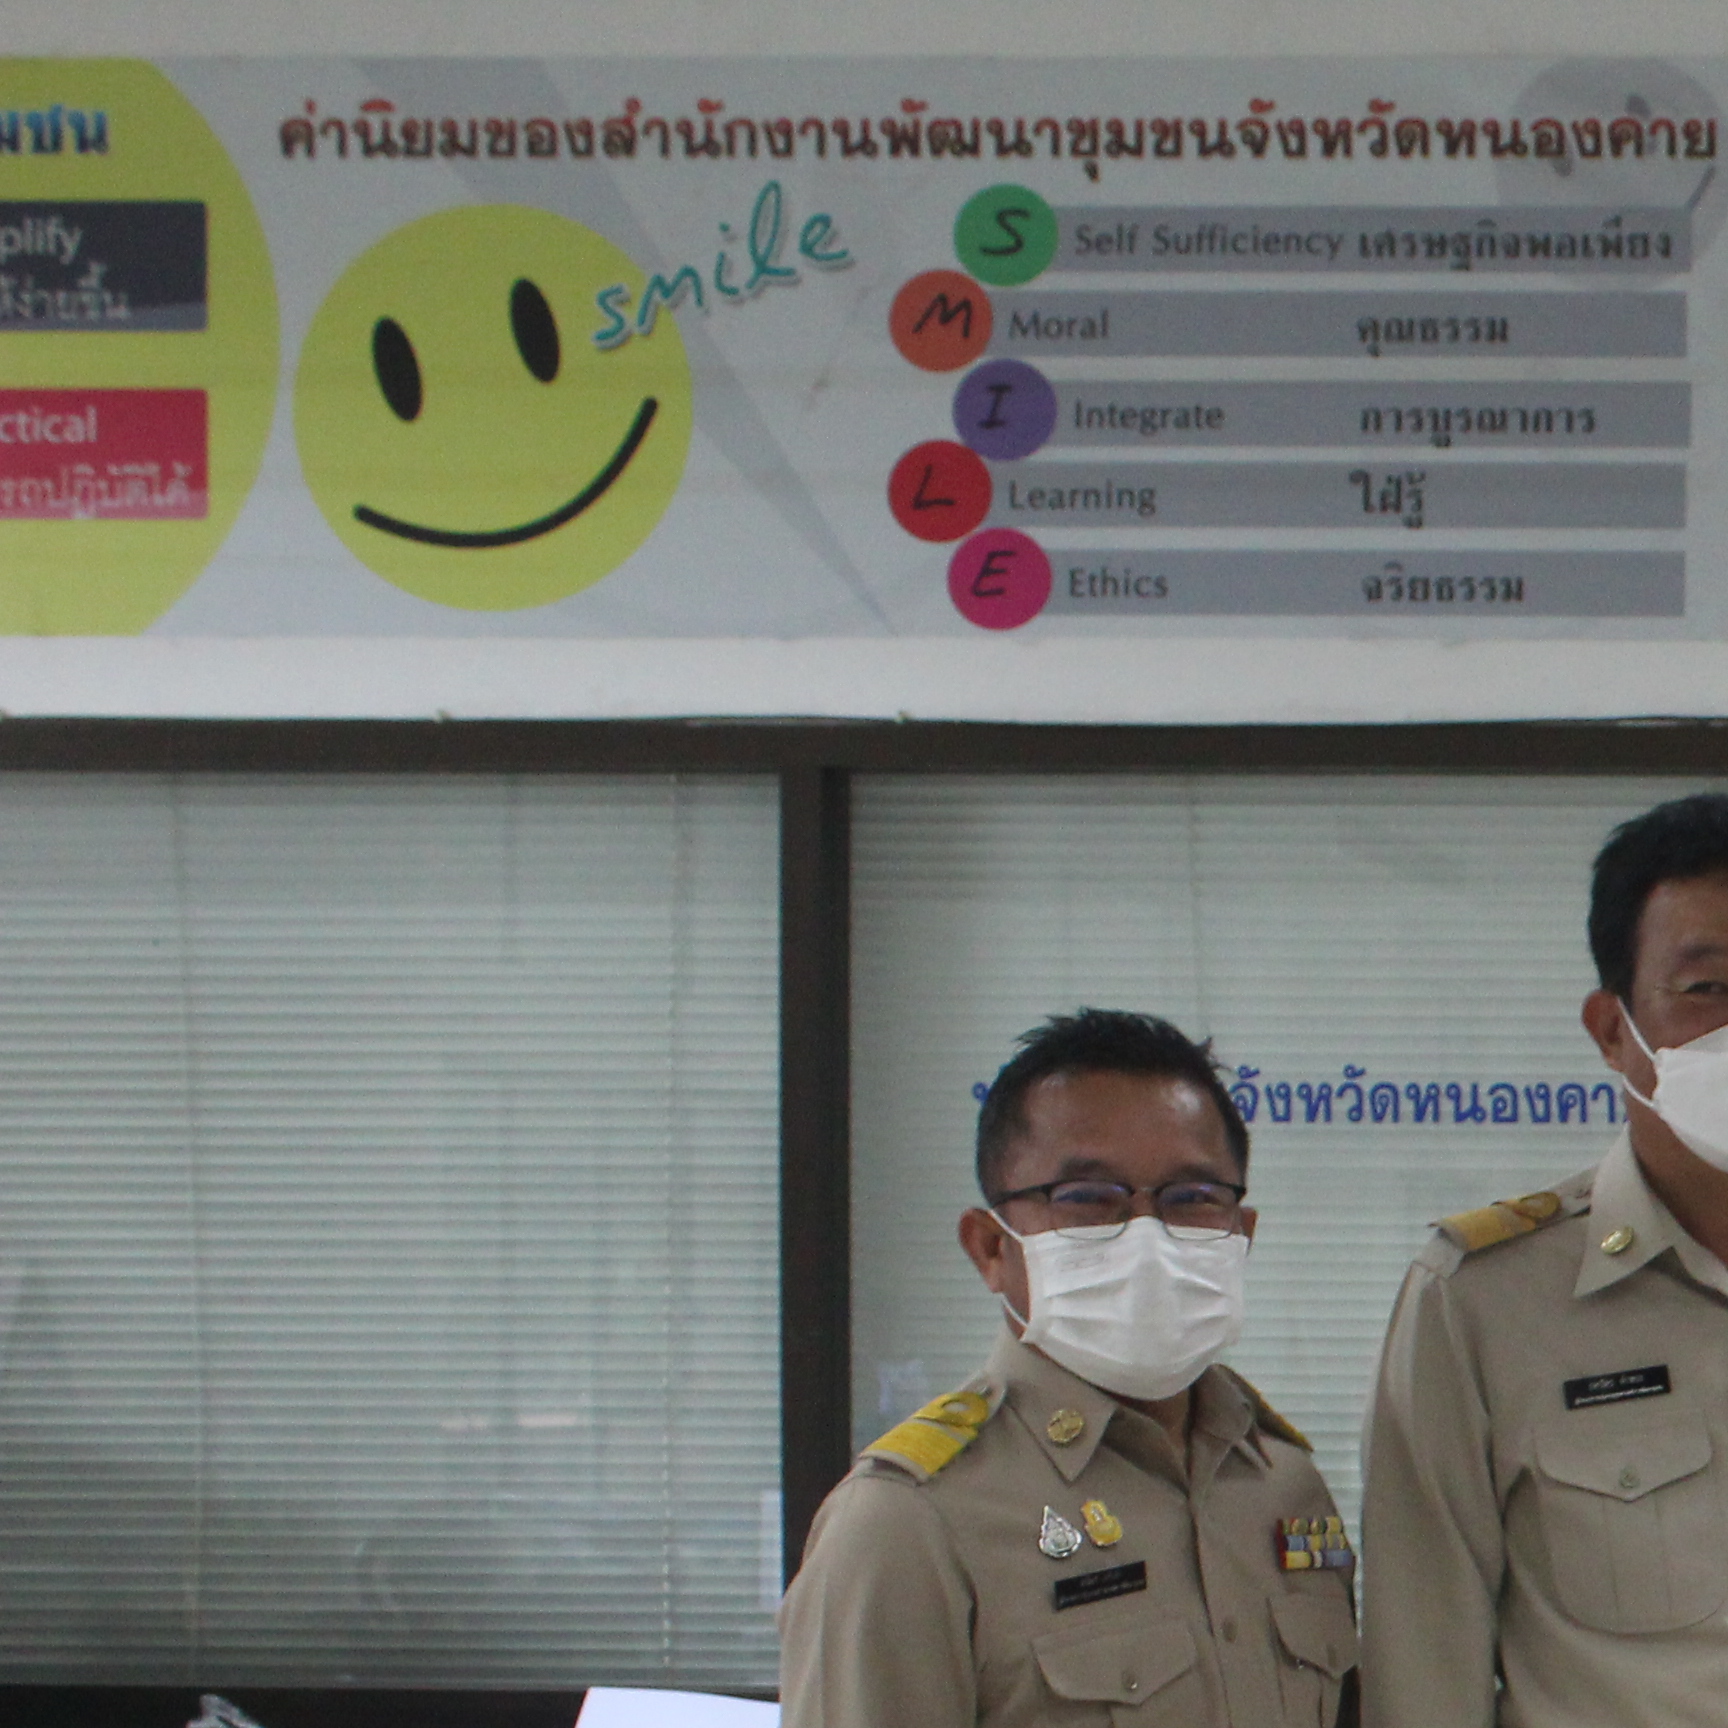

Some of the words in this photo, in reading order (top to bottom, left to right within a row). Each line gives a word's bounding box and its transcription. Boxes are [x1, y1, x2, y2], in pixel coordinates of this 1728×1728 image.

[980, 208, 1031, 257] S
[1075, 223, 1138, 256] Self
[1151, 222, 1344, 261] Sufficiency
[593, 179, 849, 348] smile
[912, 293, 973, 339] M
[1008, 310, 1110, 340] Moral
[1357, 315, 1509, 358] คุณธรรม
[1074, 402, 1226, 435] Integrate
[1360, 406, 1596, 448] การบูรณาการ
[912, 464, 954, 511] L
[1008, 480, 1157, 517] Learning
[971, 550, 1015, 598] E
[1068, 567, 1169, 600] Ethics
[1233, 1064, 1628, 1124] จังหวัดหนองคา
